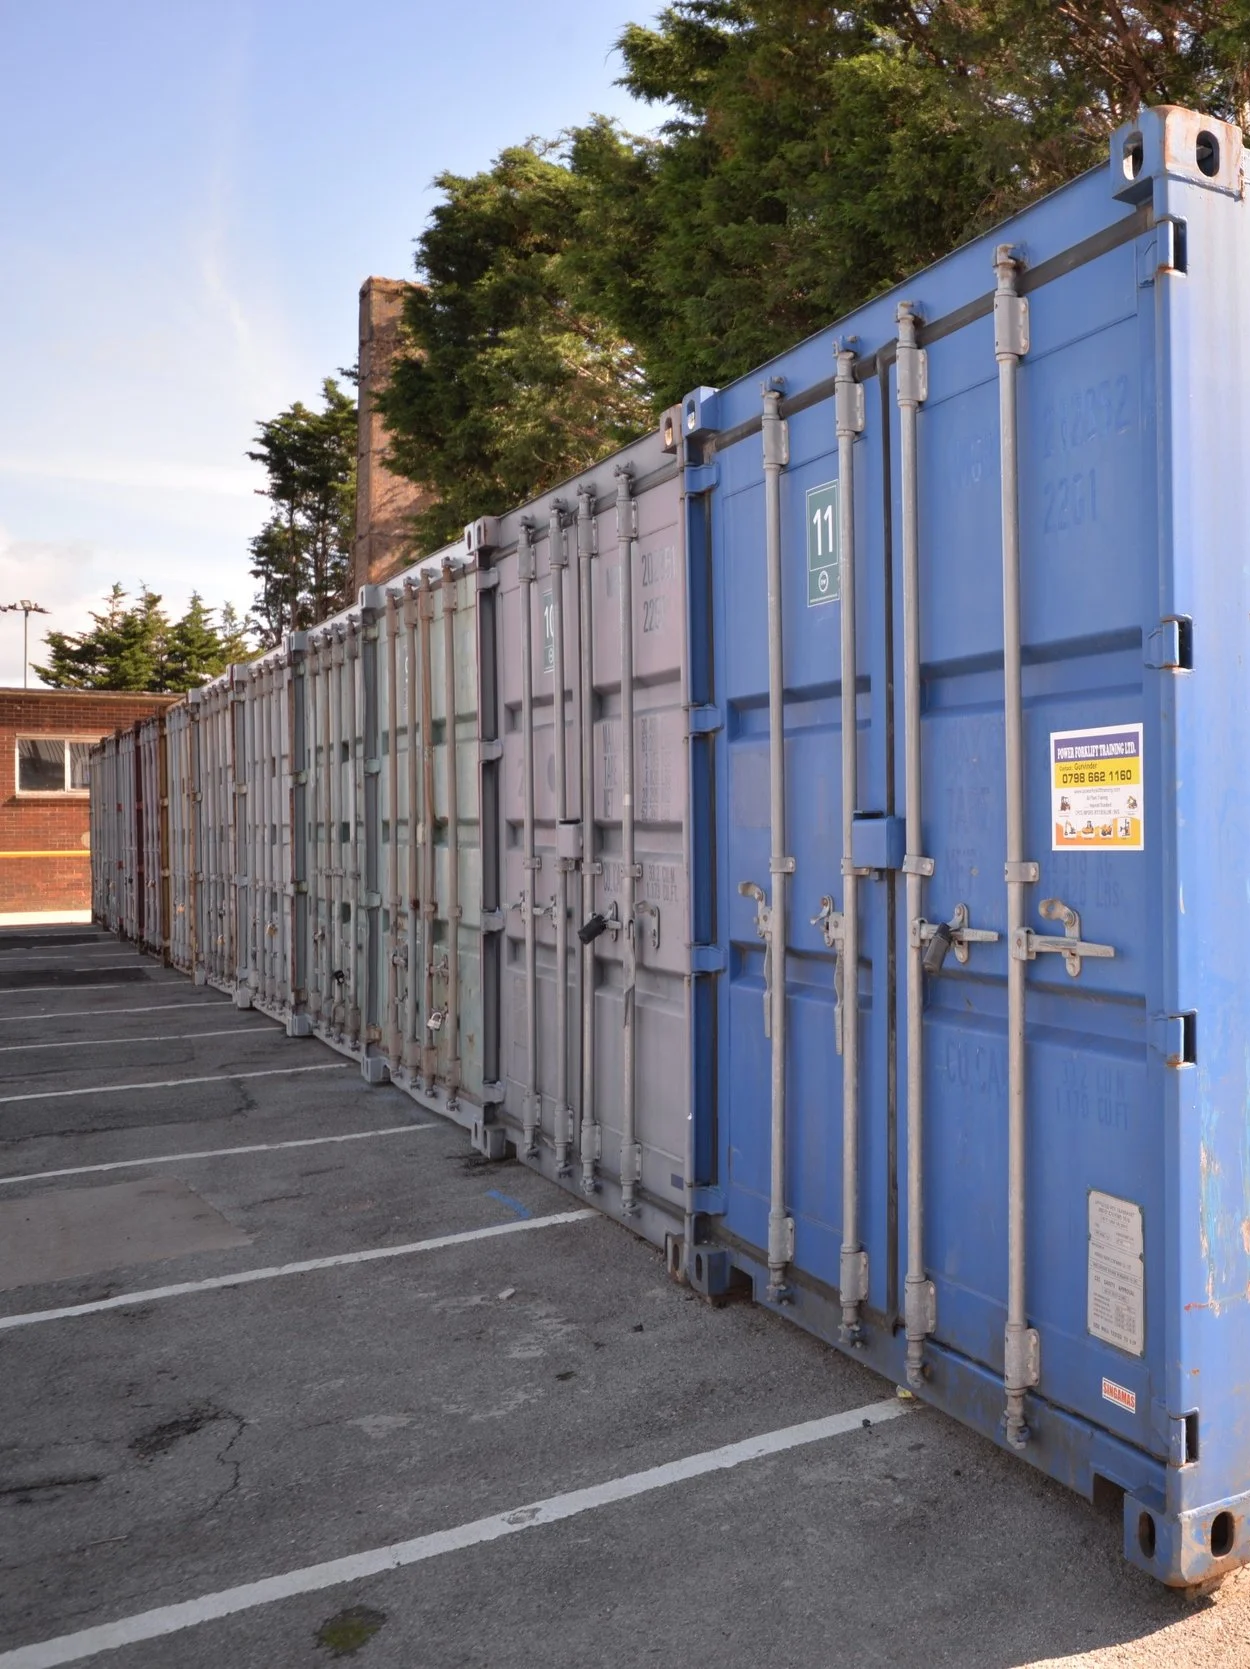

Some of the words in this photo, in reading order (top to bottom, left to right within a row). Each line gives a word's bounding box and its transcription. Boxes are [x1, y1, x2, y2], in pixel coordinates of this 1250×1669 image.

[812, 504, 833, 556] 11
[1057, 747, 1075, 760] POWER
[1075, 744, 1099, 759] FORKLIFT
[1099, 742, 1125, 757] TRAINING
[1062, 773, 1085, 784] 0798
[1088, 771, 1106, 783] 662
[1109, 769, 1132, 781] 1160
[1104, 1381, 1135, 1408] SINGAMAS
